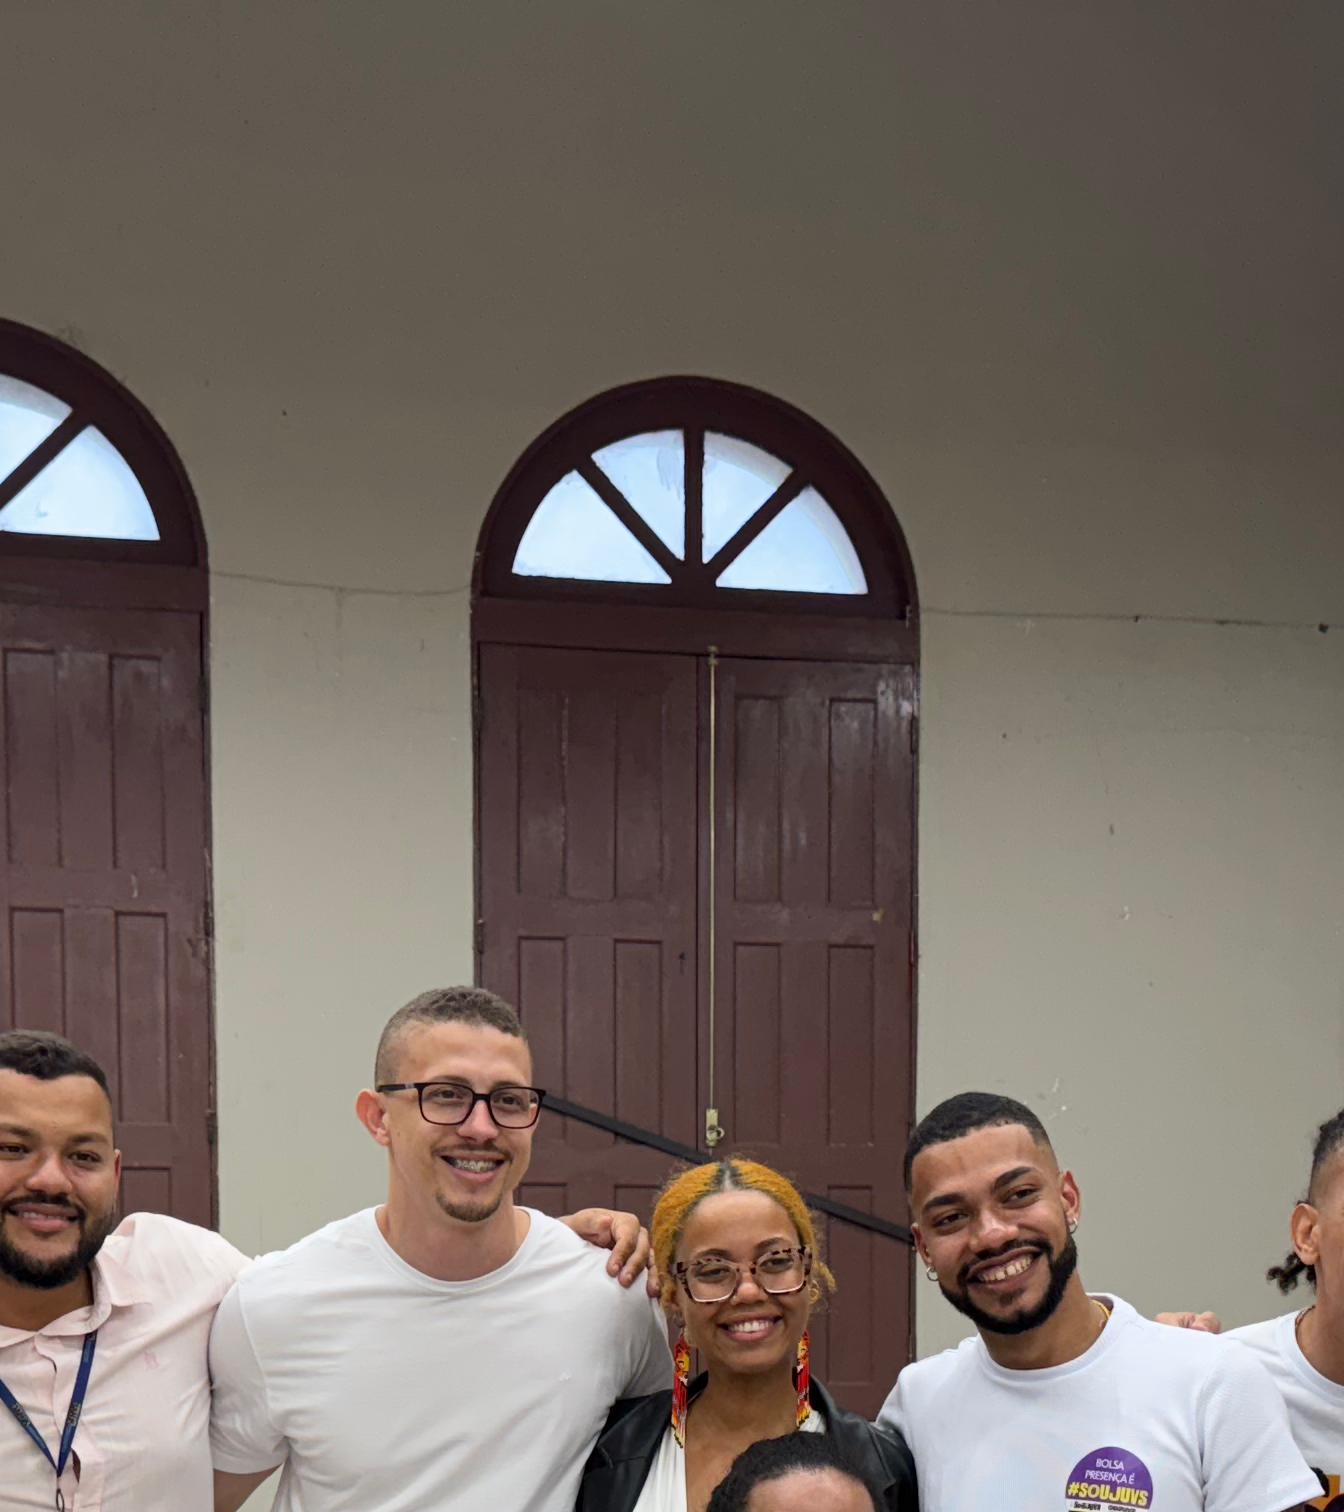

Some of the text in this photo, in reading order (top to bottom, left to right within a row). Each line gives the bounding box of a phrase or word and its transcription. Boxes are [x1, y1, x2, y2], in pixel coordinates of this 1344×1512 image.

[1095, 1458, 1125, 1470] BOLSA
[1084, 1469, 1128, 1485] PRESENÇA
[1067, 1481, 1149, 1507] #SOUJUVS
